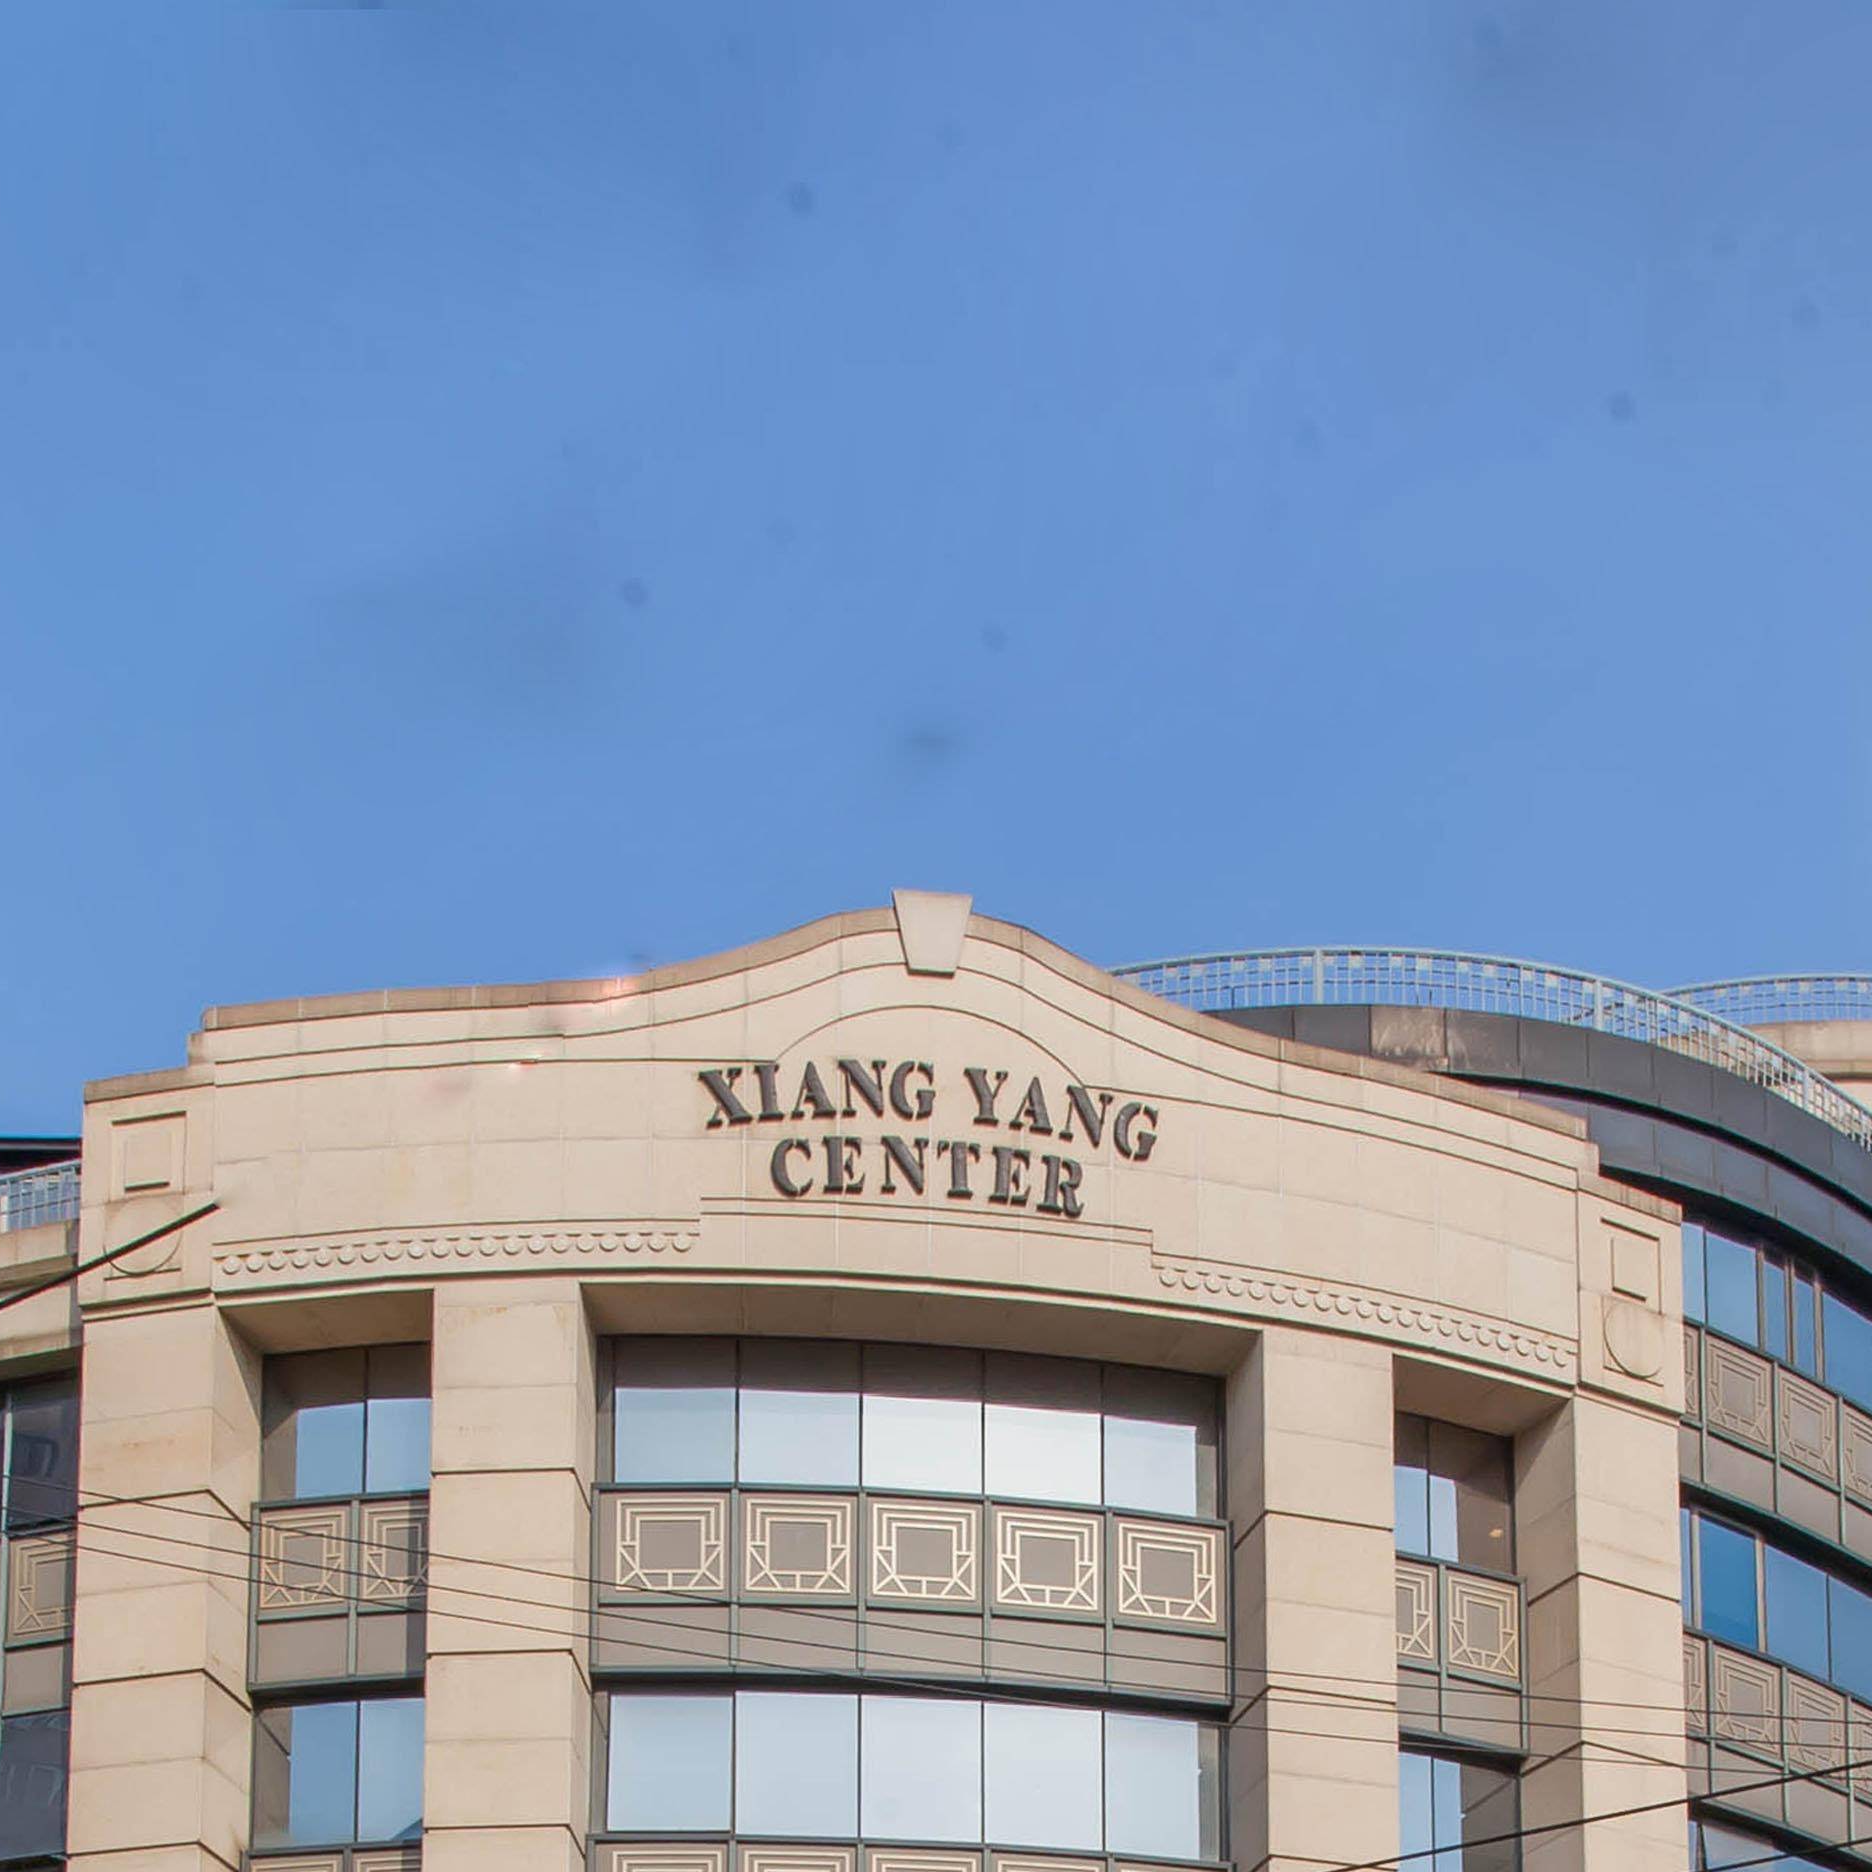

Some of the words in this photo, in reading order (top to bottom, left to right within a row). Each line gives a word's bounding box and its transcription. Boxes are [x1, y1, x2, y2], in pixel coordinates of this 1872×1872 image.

[698, 1060, 935, 1128] XIANG
[963, 1067, 1159, 1161] YANG
[770, 1136, 1085, 1218] CENTER
